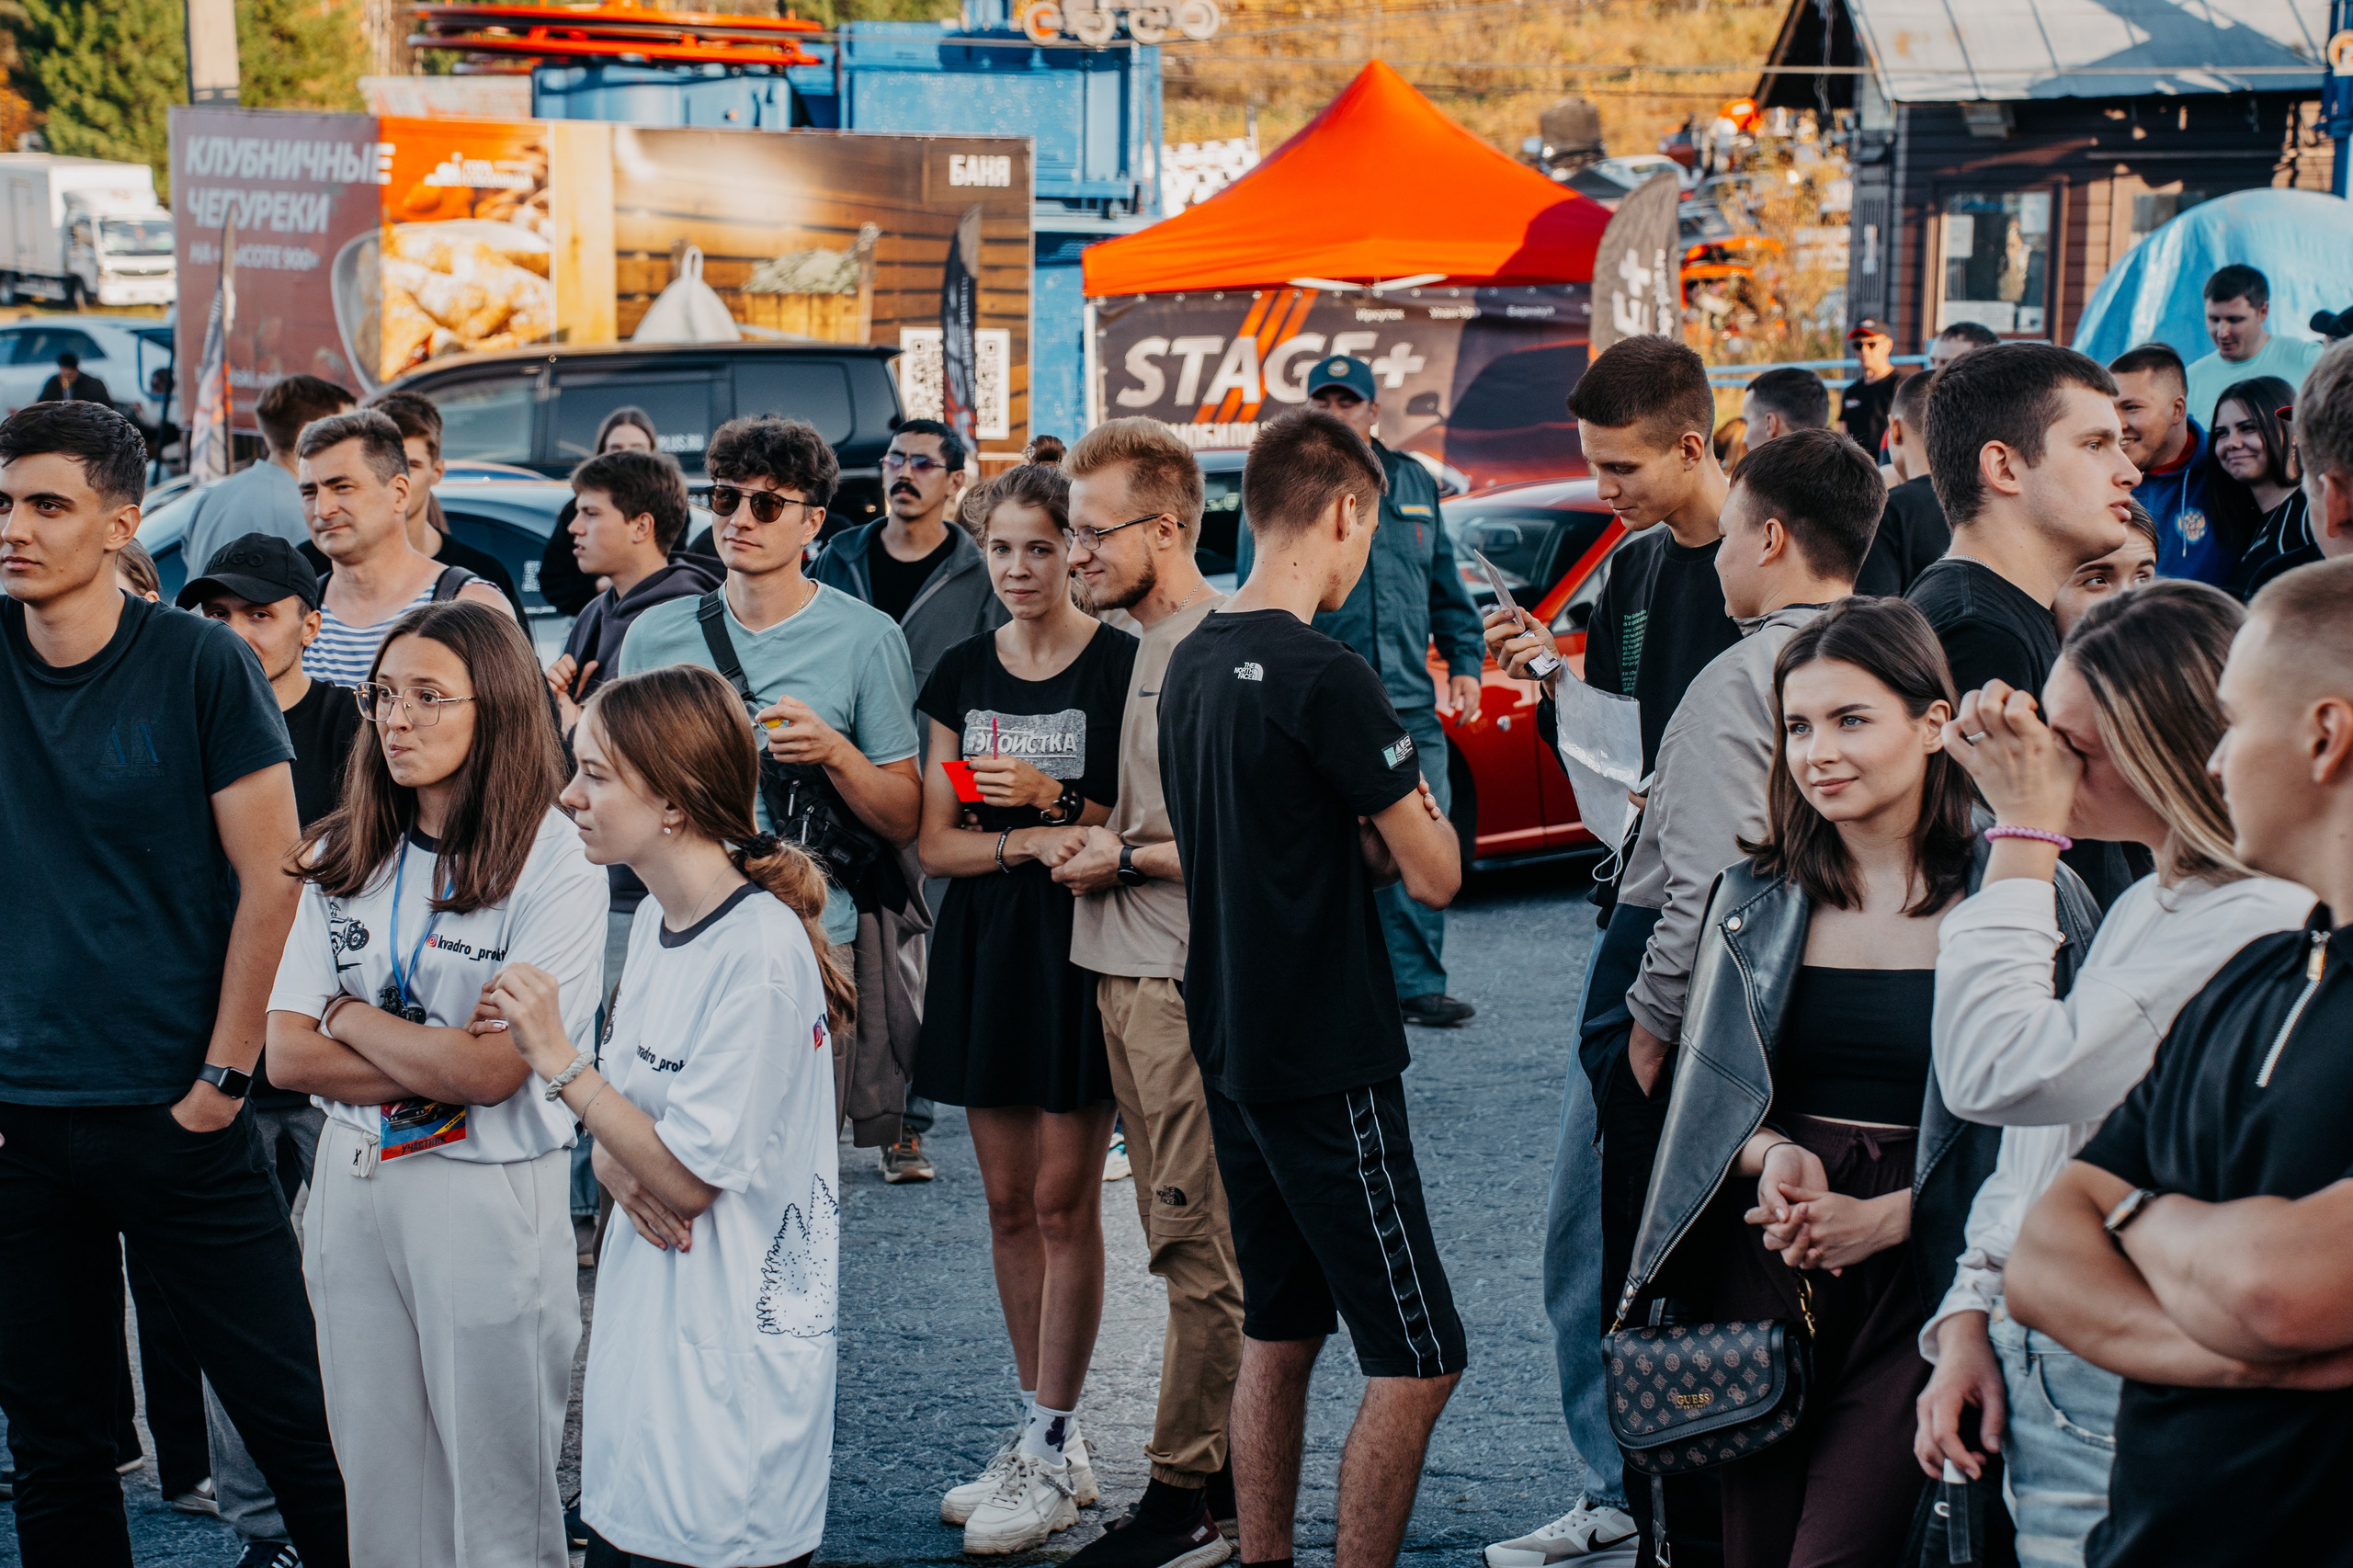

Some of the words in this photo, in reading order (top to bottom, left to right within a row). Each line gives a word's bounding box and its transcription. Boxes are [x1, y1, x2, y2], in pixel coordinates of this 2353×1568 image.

[186, 135, 395, 185] КЛУБНИЧНЫЕ
[949, 154, 1011, 187] БАНЯ
[636, 1040, 686, 1073] vadro_prok
[402, 1134, 447, 1155] УЧАСТНИК
[1677, 1393, 1711, 1405] GUESS
